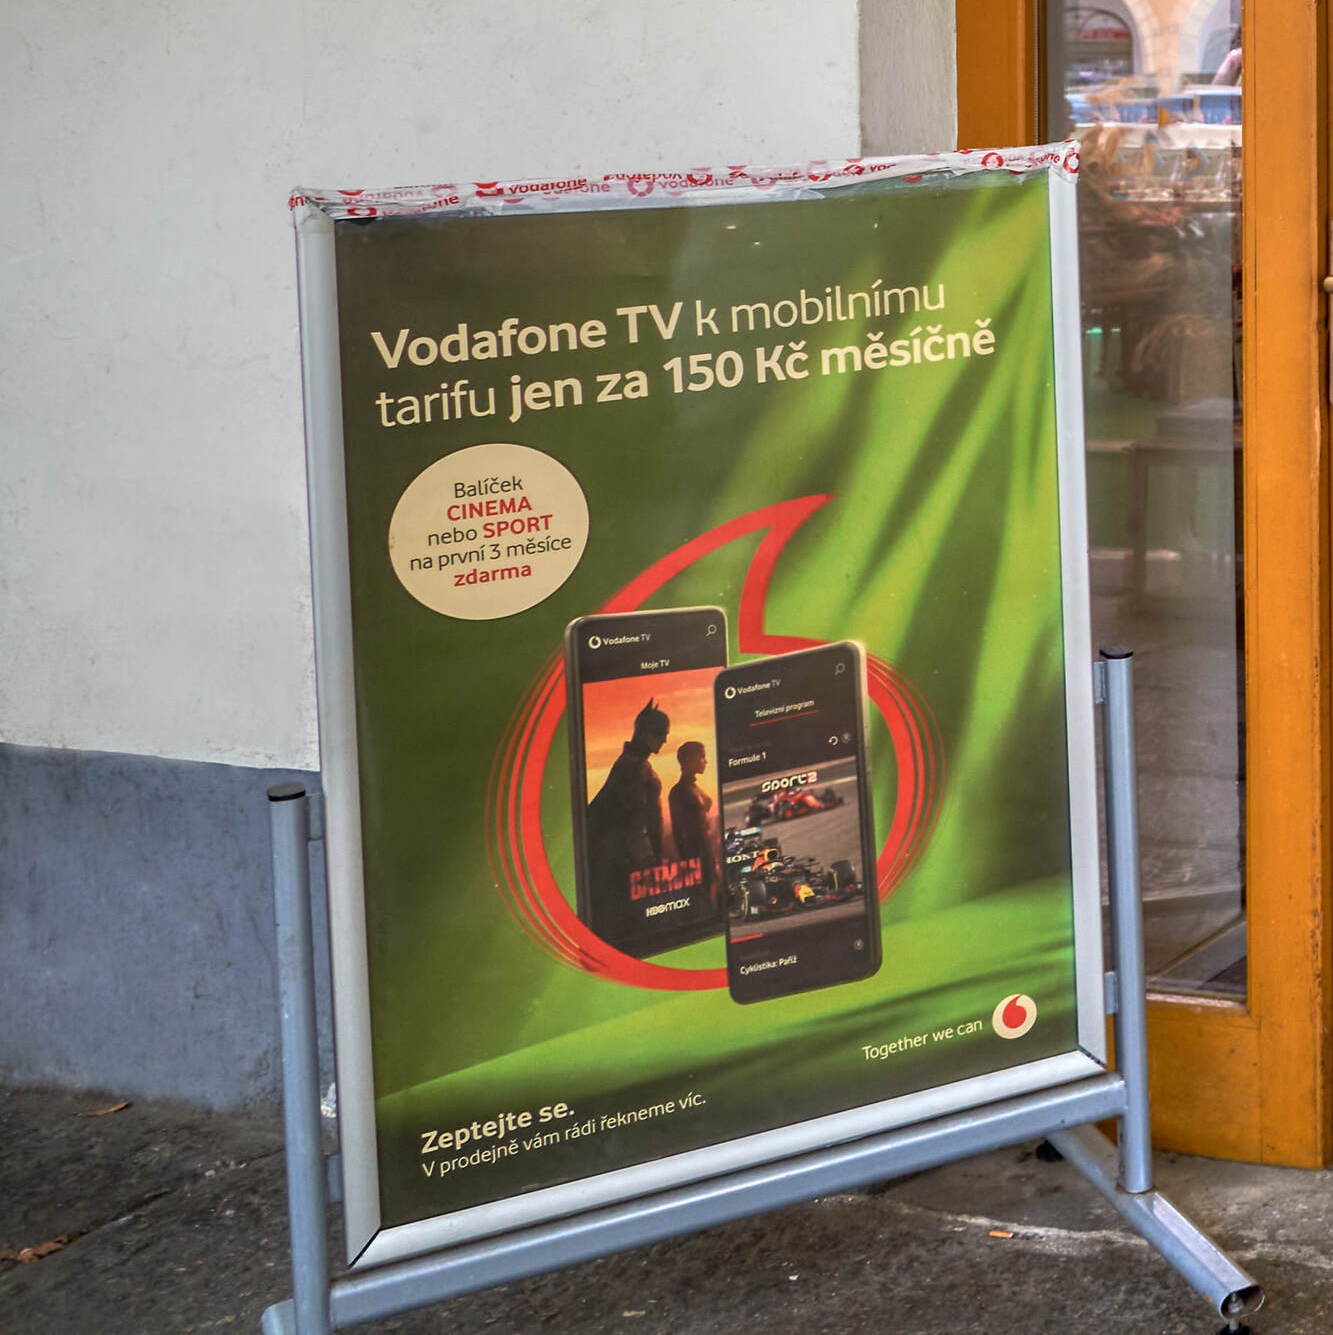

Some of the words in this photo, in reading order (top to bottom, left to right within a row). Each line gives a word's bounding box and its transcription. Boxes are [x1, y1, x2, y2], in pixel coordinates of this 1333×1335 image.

[370, 317, 607, 370] Vodafone
[616, 301, 683, 345] TV
[695, 299, 720, 336] k
[731, 278, 945, 333] mobilnímu
[375, 379, 496, 427] tarifu
[508, 374, 583, 424] jen
[595, 368, 649, 403] za
[663, 350, 744, 393] 150
[756, 340, 809, 384] Kč
[820, 317, 996, 376] měsíčně
[454, 476, 524, 499] Balíček
[447, 496, 533, 521] CINEMA
[427, 527, 478, 546] nebo
[483, 514, 553, 539] SPORT
[410, 555, 433, 571] na
[438, 545, 485, 571] první
[489, 544, 501, 560] 3
[506, 536, 572, 558] měsíce
[453, 564, 532, 587] zdarma
[602, 635, 640, 646] Vodafone
[640, 633, 652, 642] TV
[659, 659, 671, 668] TV
[737, 682, 771, 695] Vodafone
[728, 753, 760, 768] Formule
[862, 1033, 928, 1061] Together
[932, 1027, 954, 1042] we
[957, 1019, 983, 1037] can
[420, 1110, 533, 1155] Zeptejte
[538, 1100, 576, 1124] se.
[422, 1160, 436, 1177] V
[439, 1138, 519, 1177] prodejně
[523, 1129, 560, 1152] vám
[565, 1118, 597, 1142] rádi
[600, 1100, 676, 1132] řekneme
[679, 1091, 707, 1111] víc.
